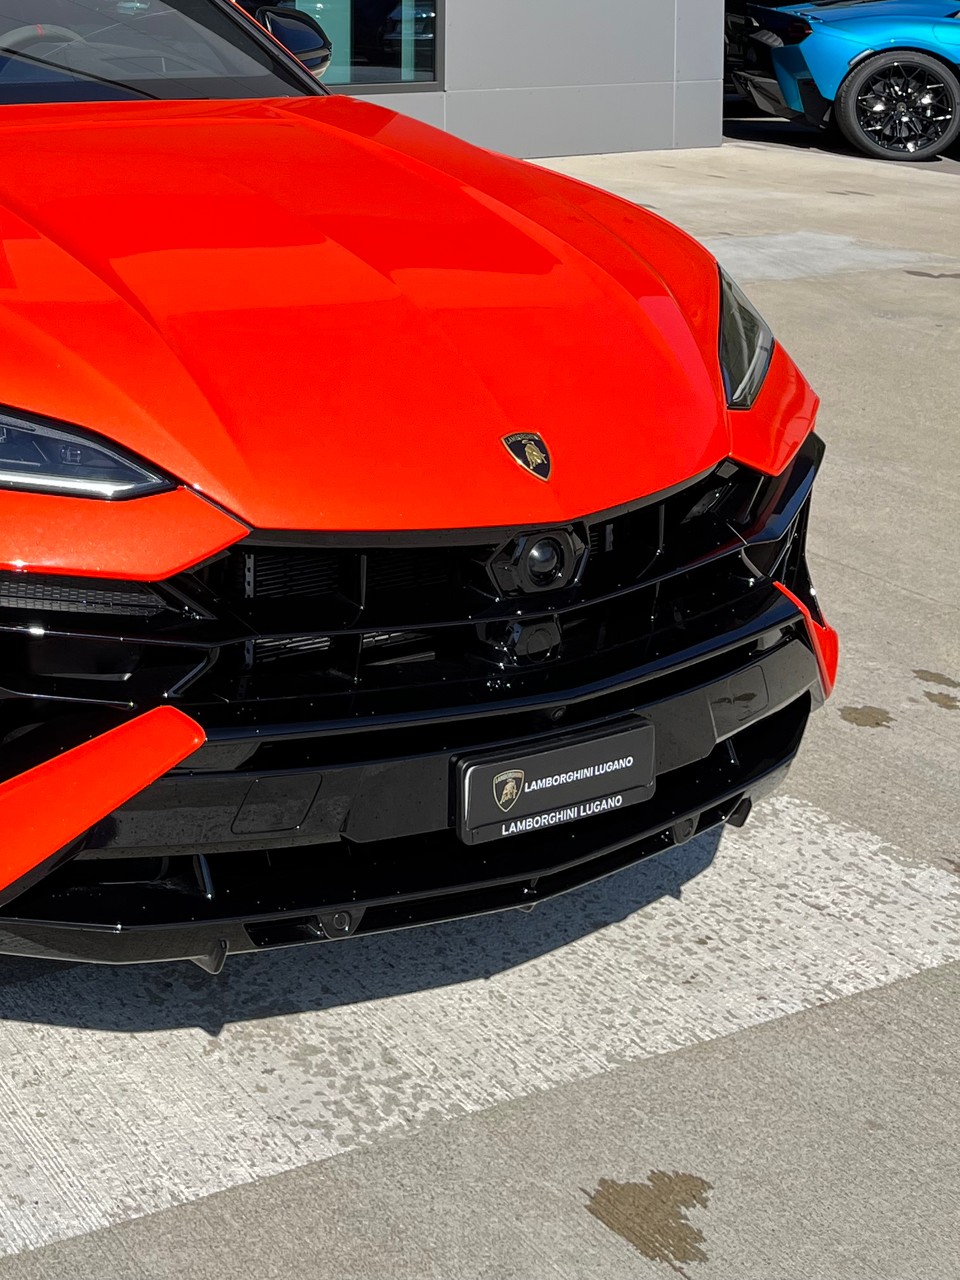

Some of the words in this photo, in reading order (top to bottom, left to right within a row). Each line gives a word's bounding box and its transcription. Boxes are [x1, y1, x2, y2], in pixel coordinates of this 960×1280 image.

[524, 767, 594, 793] LAMBORGHINI
[594, 756, 634, 775] LUGANO
[501, 806, 578, 836] LAMBORGHINI
[579, 795, 623, 817] LUGANO
